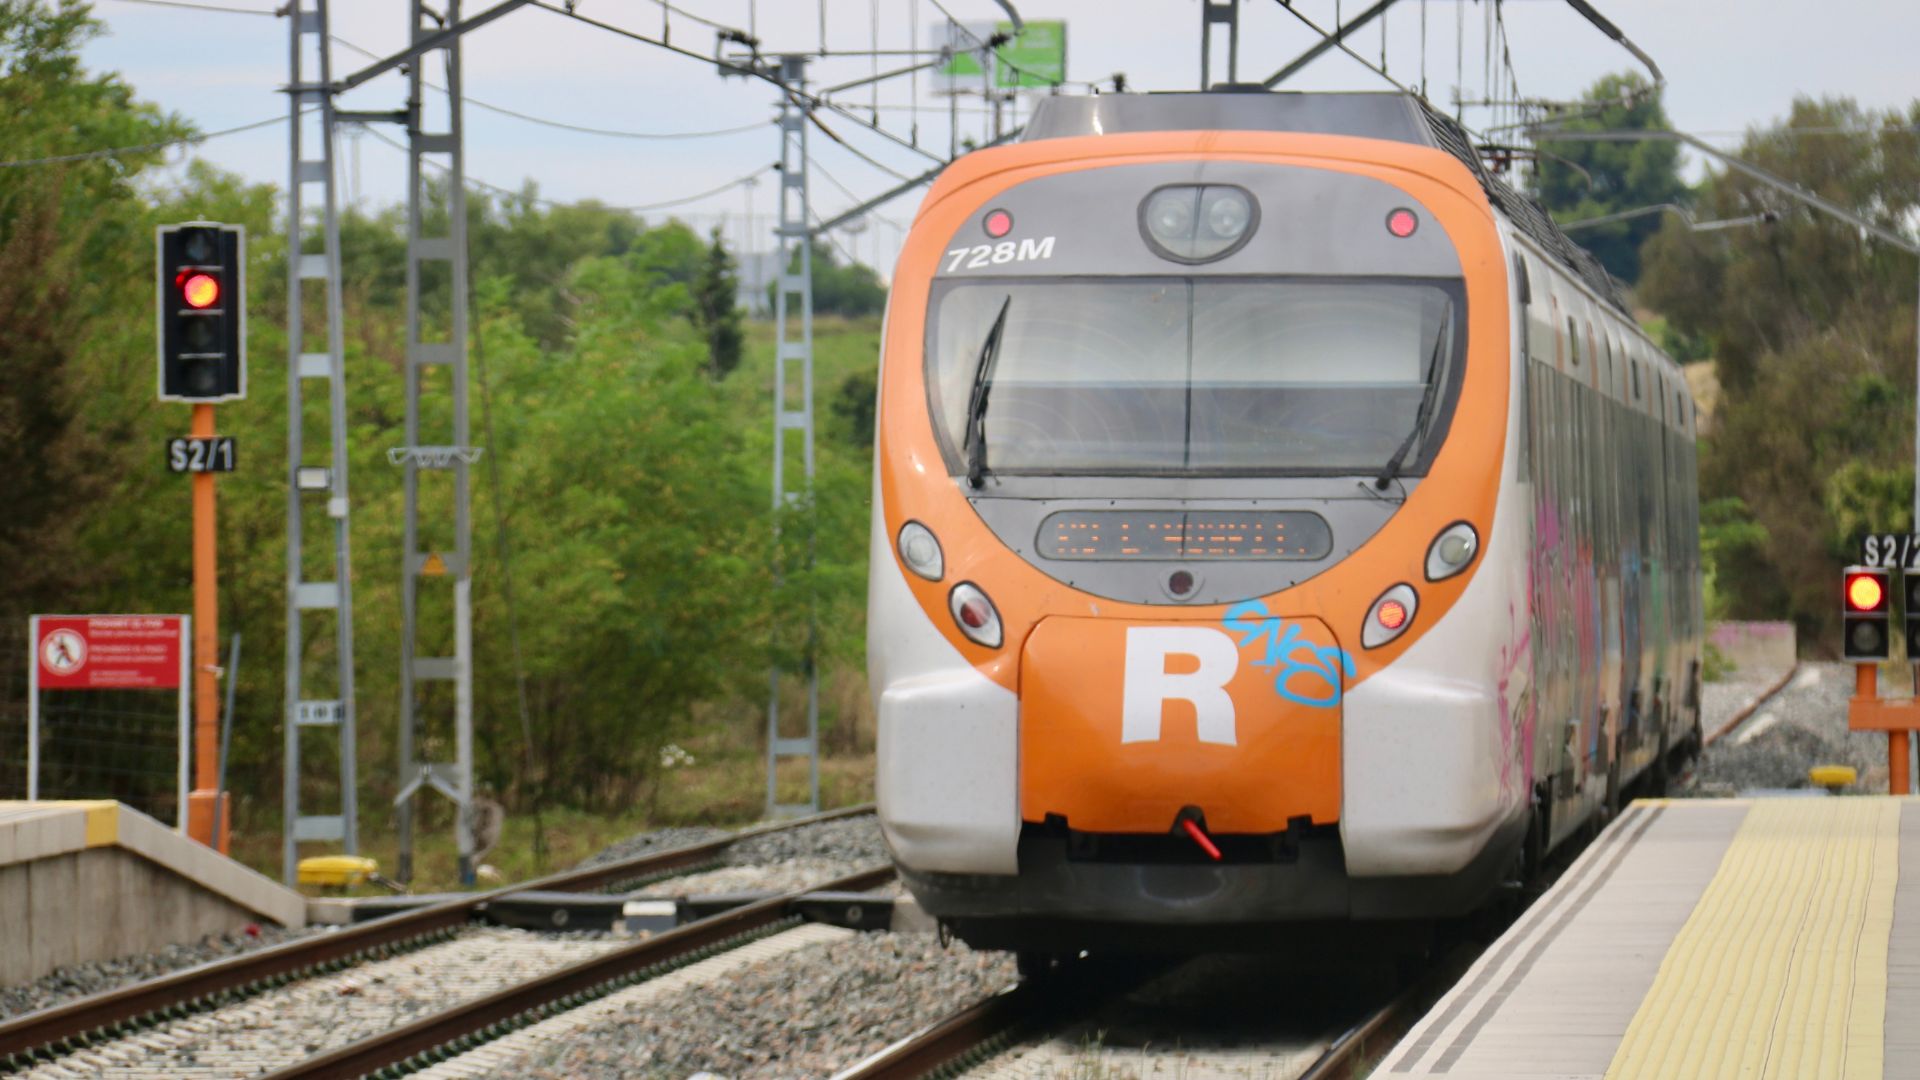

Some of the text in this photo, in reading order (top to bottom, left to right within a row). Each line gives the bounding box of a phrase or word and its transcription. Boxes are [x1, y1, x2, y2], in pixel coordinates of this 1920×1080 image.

[946, 236, 1056, 273] 728M
[170, 438, 233, 472] S2/1
[1121, 626, 1239, 747] R
